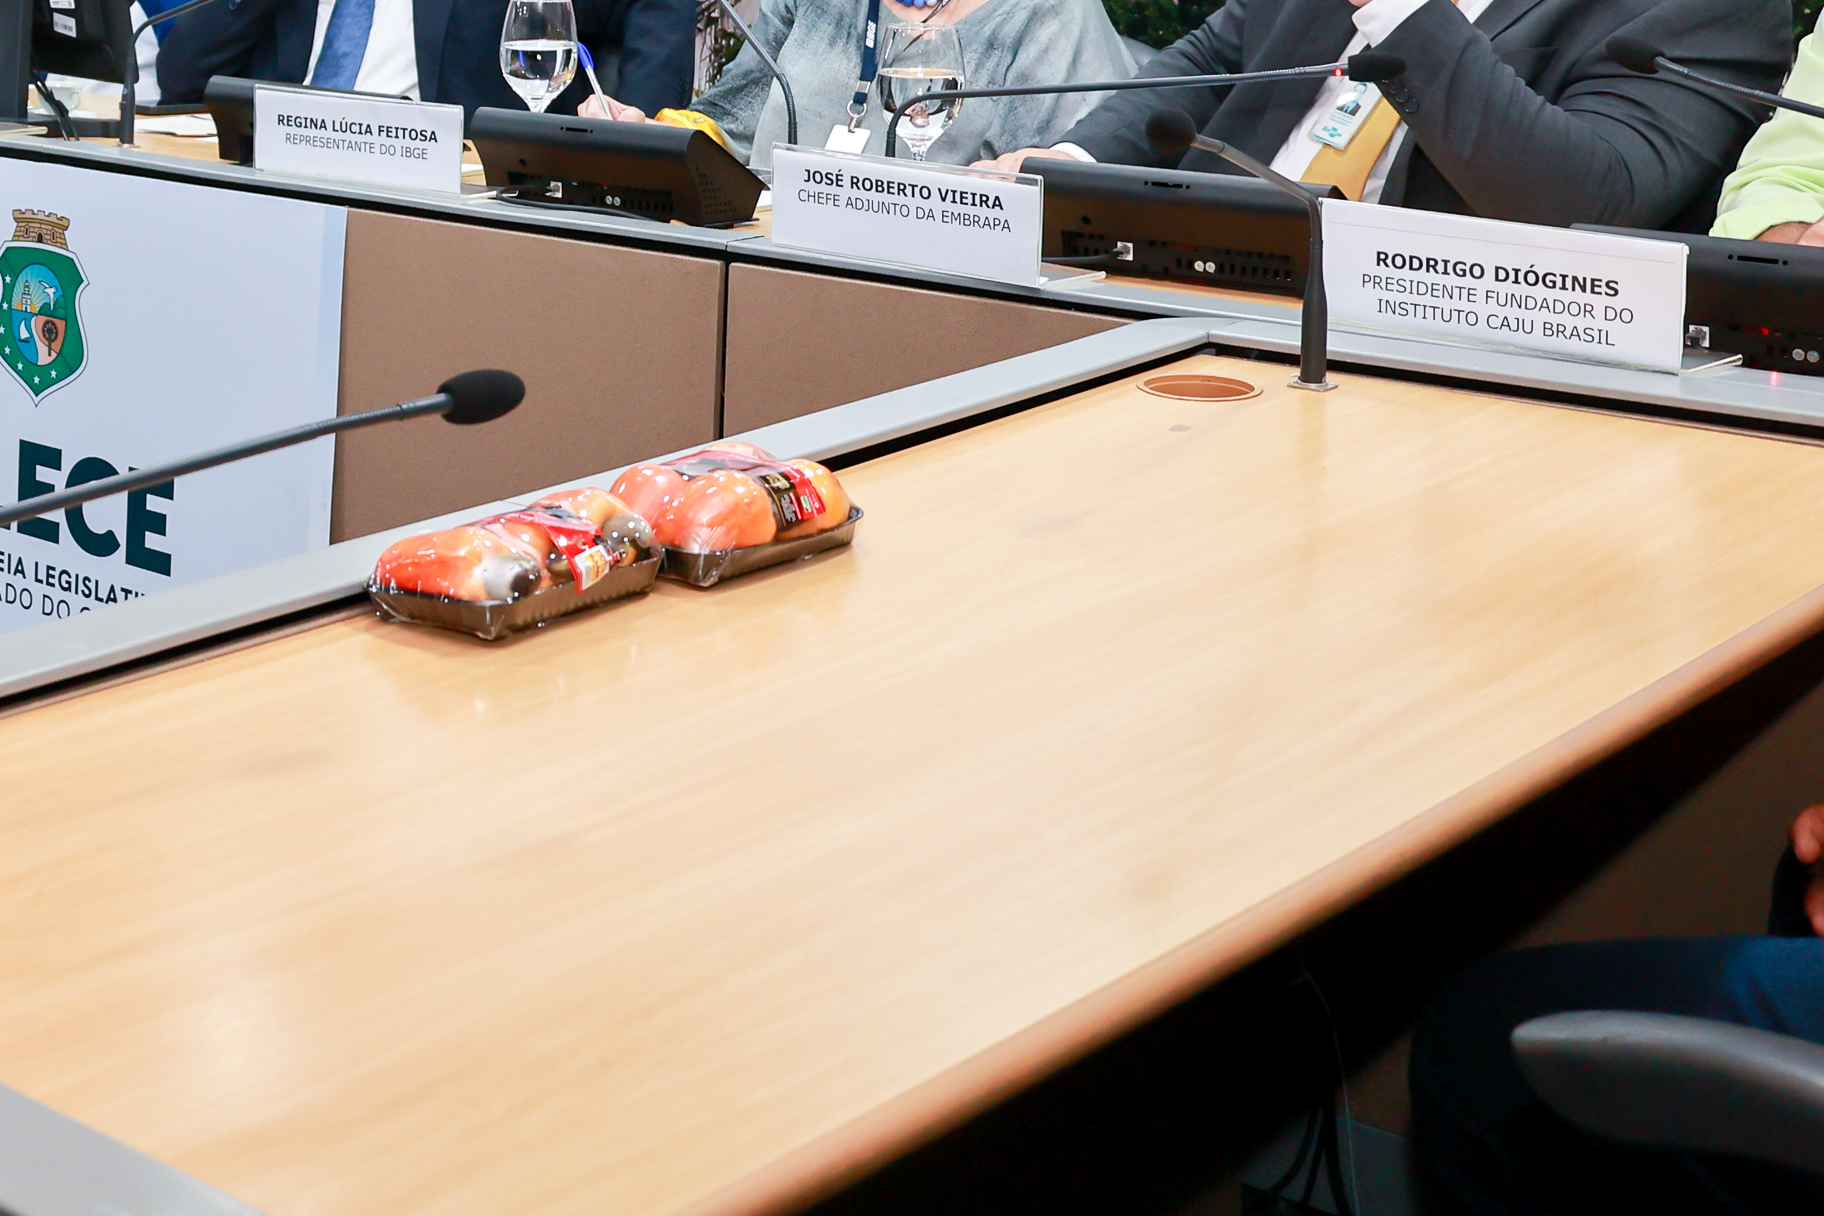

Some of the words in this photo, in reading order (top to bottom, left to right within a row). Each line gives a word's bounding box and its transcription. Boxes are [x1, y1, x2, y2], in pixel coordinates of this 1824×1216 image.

[866, 19, 877, 41] IBGE
[277, 114, 328, 132] REGINA
[332, 117, 373, 136] LÚCIA
[378, 125, 438, 143] FEITOSA
[285, 132, 376, 154] REPRESENTANTE
[379, 143, 397, 157] DO
[400, 145, 429, 160] IBGE
[797, 189, 841, 207] CHEFE
[845, 196, 910, 218] ADJUNTO
[915, 206, 936, 222] DA
[941, 210, 1012, 233] EMBRAPA
[803, 169, 844, 188] JOSÉ
[850, 175, 932, 201] ROBERTO
[937, 187, 1004, 211] VIEIRA
[1375, 250, 1485, 280] RODRIGO
[1494, 264, 1620, 297] DIÓGINES
[1361, 273, 1478, 304] PRESIDENTE
[1485, 289, 1596, 320] FUNDADOR
[1604, 305, 1634, 325] DO
[1377, 298, 1479, 327] INSTITUTO
[1485, 313, 1535, 335] CAJU
[1542, 321, 1616, 347] BRASIL
[42, 593, 71, 620] DO
